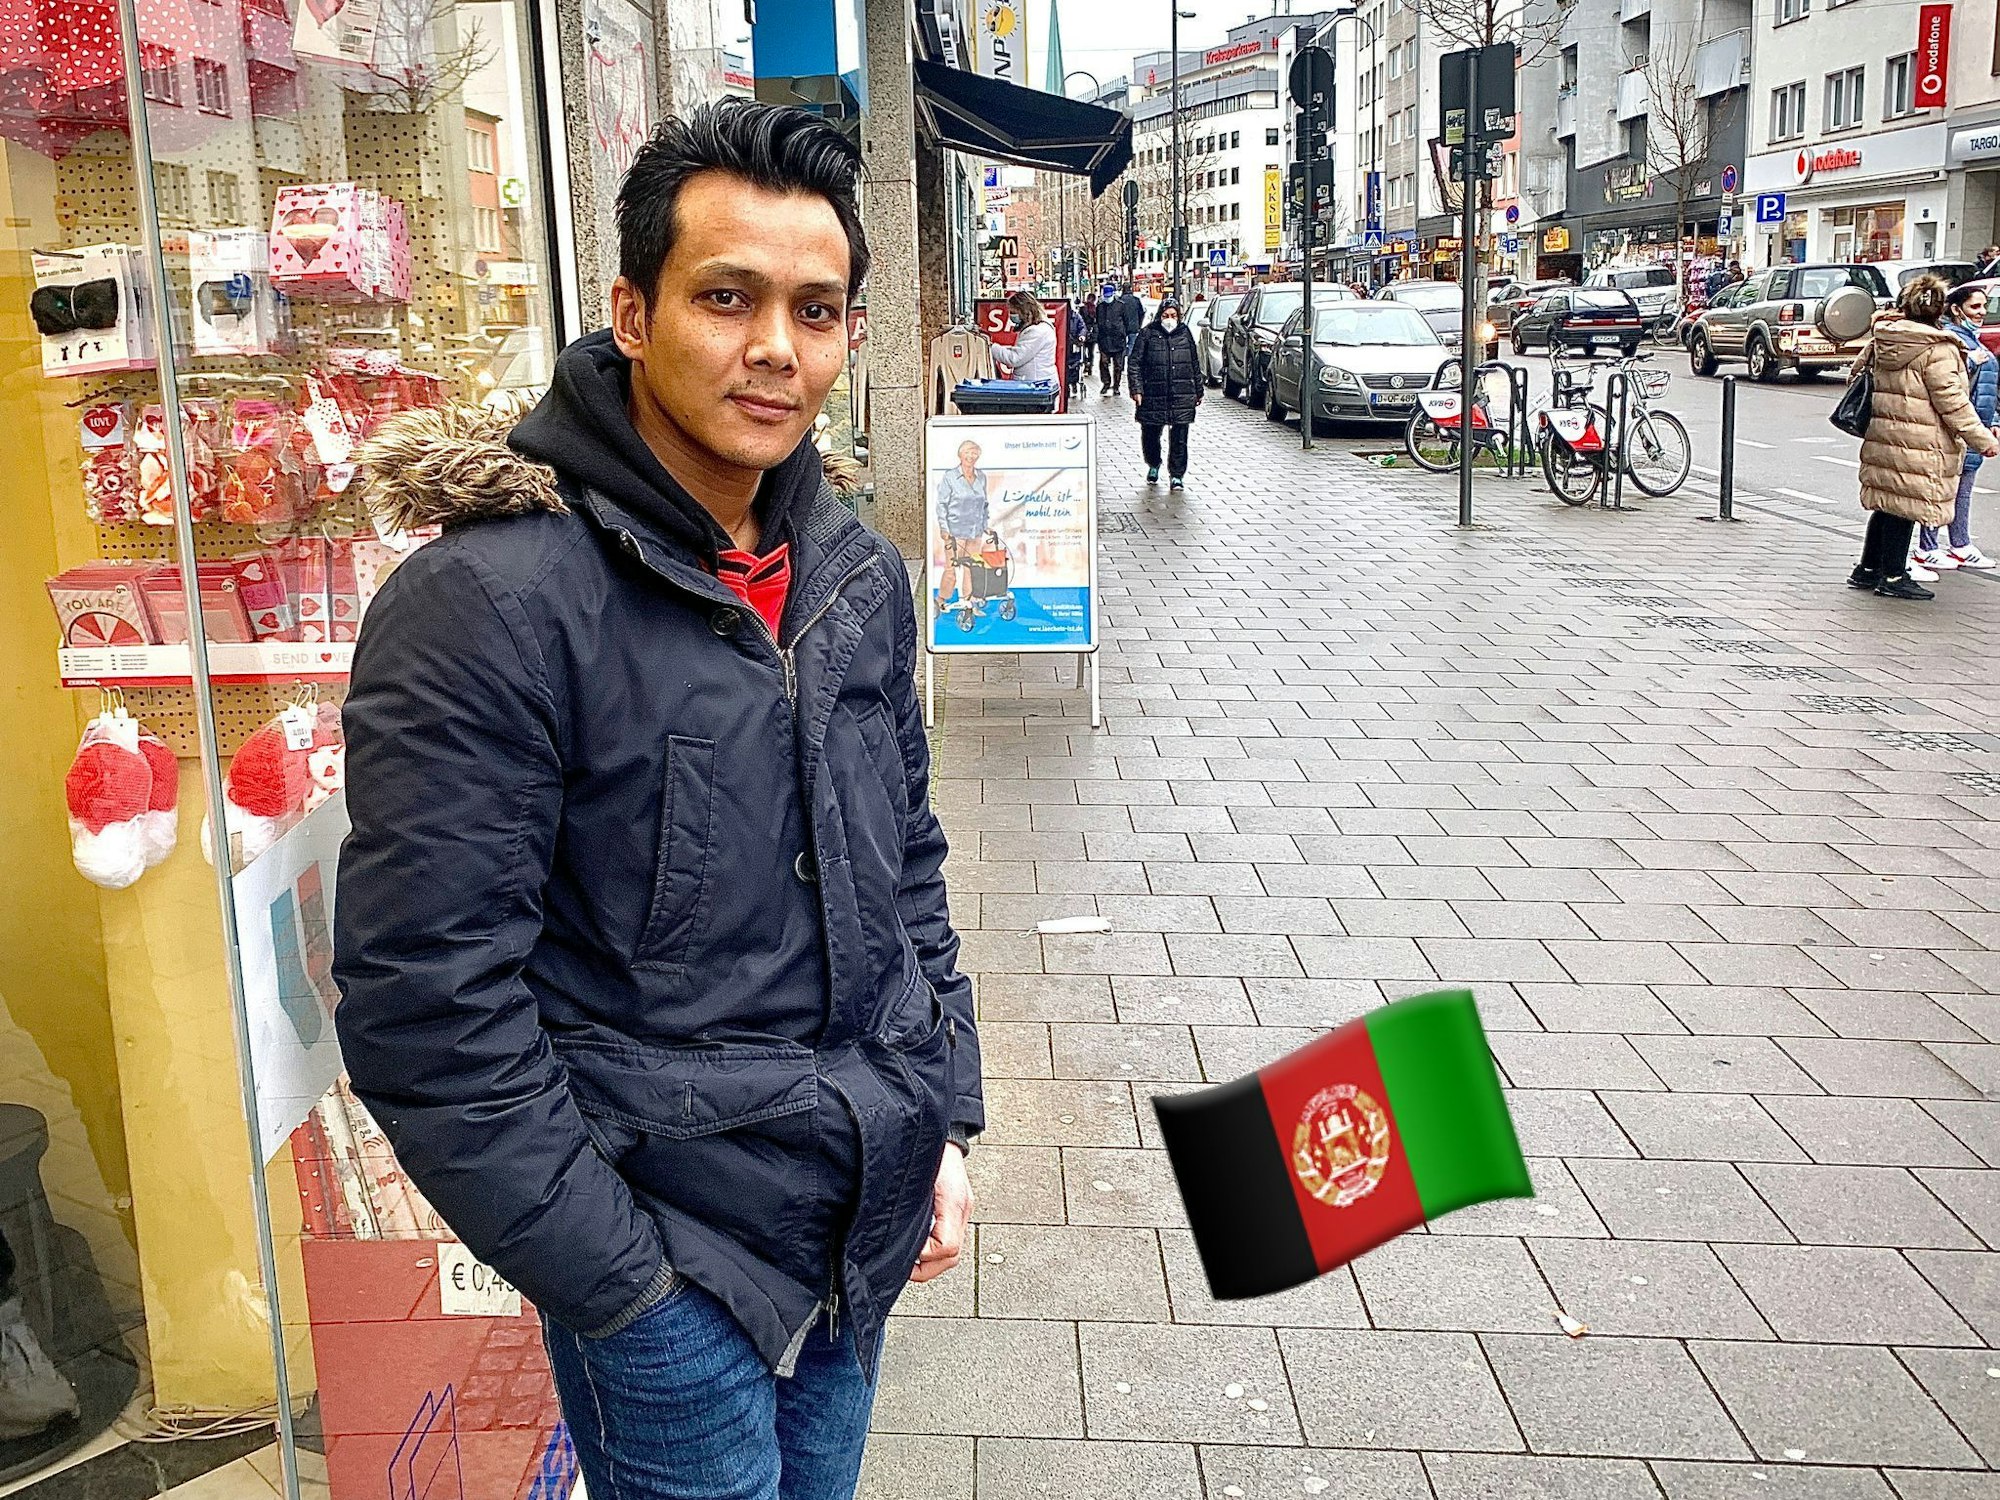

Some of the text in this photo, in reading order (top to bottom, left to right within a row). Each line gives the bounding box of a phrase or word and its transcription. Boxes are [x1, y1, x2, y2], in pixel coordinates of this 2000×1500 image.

[1928, 16, 1941, 73] vodafone
[1812, 149, 1862, 172] vodafone
[1268, 182, 1277, 225] AKSU
[1763, 197, 1779, 219] P
[90, 417, 111, 428] LOVE
[1026, 505, 1071, 517] mobil sein
[63, 597, 126, 613] YOU ARE
[273, 653, 309, 665] SEND
[451, 1263, 465, 1291] €
